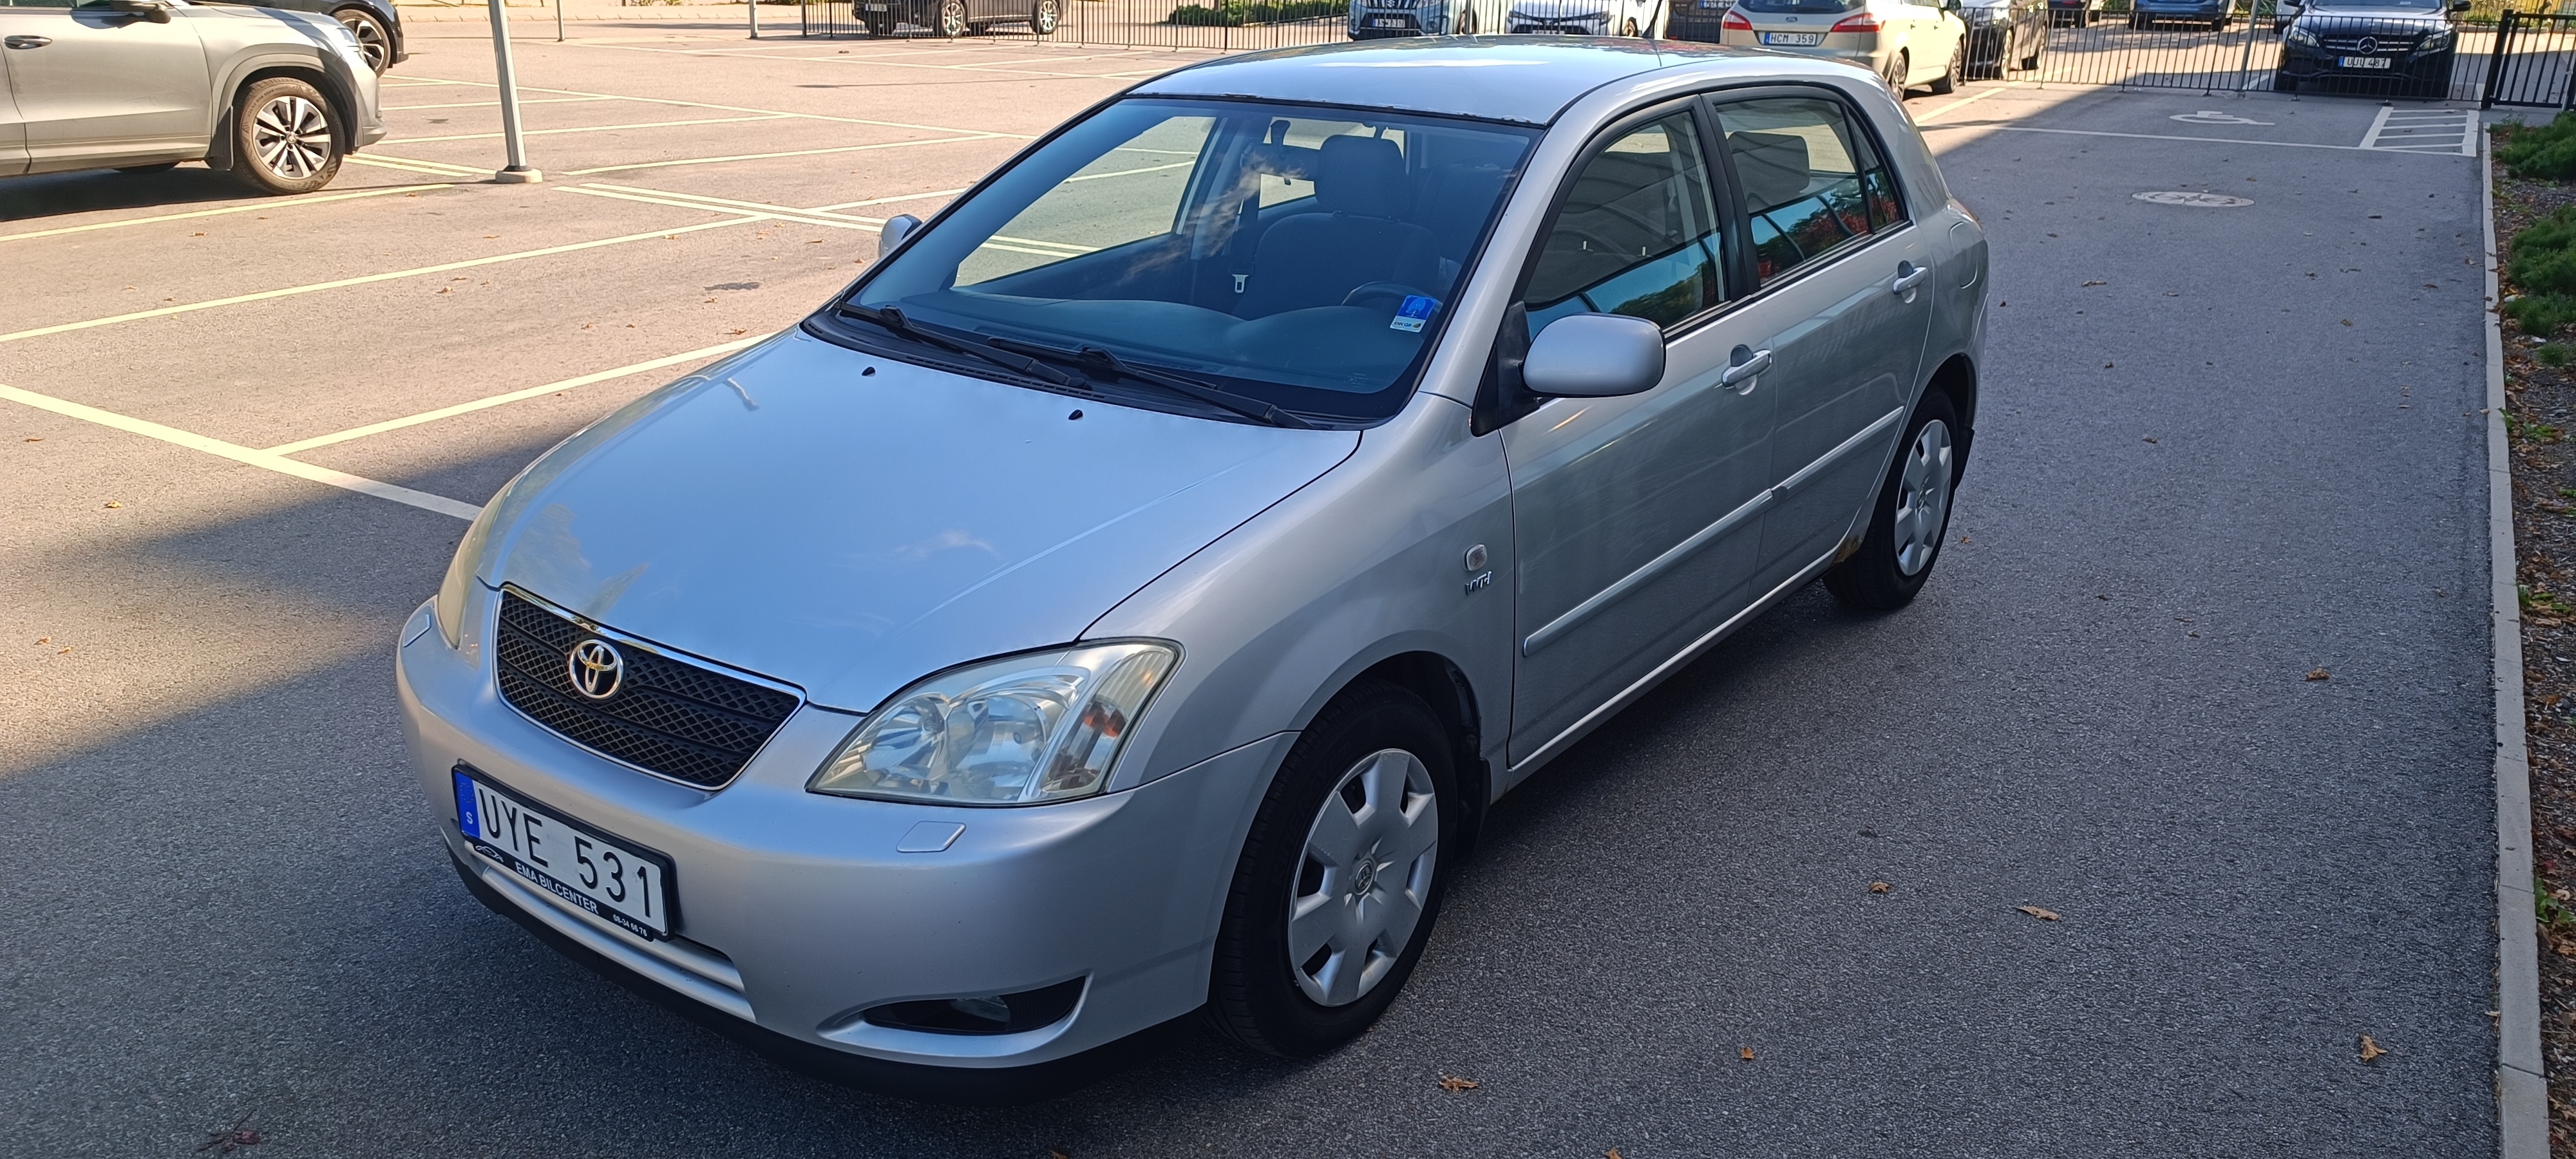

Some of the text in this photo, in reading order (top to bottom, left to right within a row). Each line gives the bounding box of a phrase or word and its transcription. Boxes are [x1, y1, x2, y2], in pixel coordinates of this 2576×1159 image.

[1770, 33, 1814, 44] HCM 359
[466, 811, 473, 825] S
[478, 787, 651, 919] UYE 531
[515, 862, 600, 915] EMA BILCENTER
